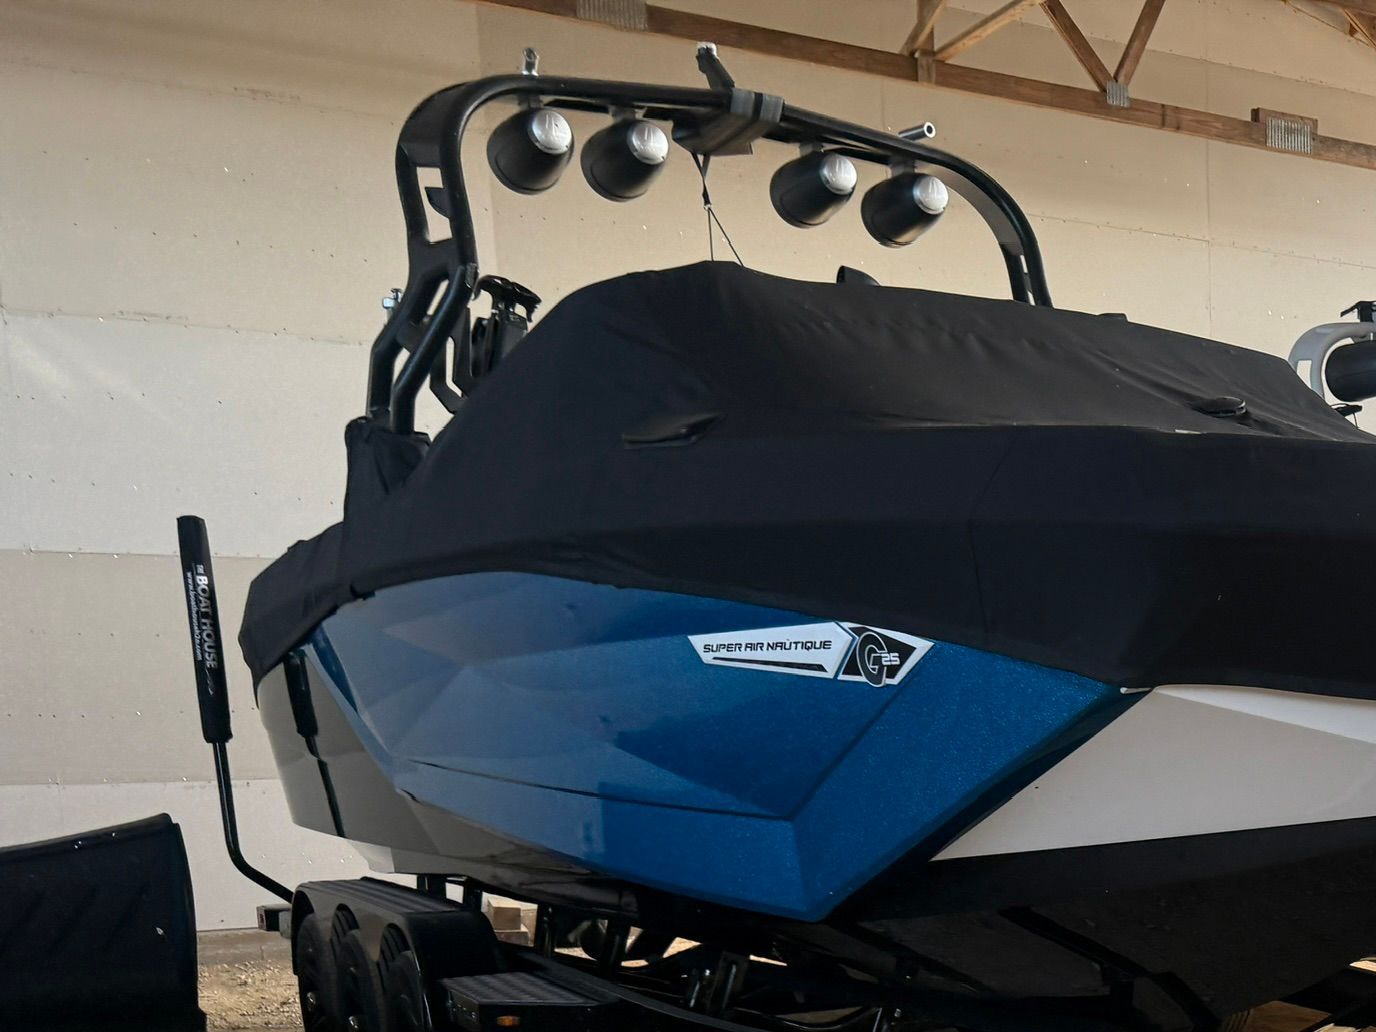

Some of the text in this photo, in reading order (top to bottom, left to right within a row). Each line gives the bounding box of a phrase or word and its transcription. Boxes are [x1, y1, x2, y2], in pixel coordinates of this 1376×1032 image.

[196, 575, 212, 614] BOAT
[201, 619, 218, 668] HOUSE
[703, 643, 742, 653] SUPER
[744, 642, 764, 652] AIR
